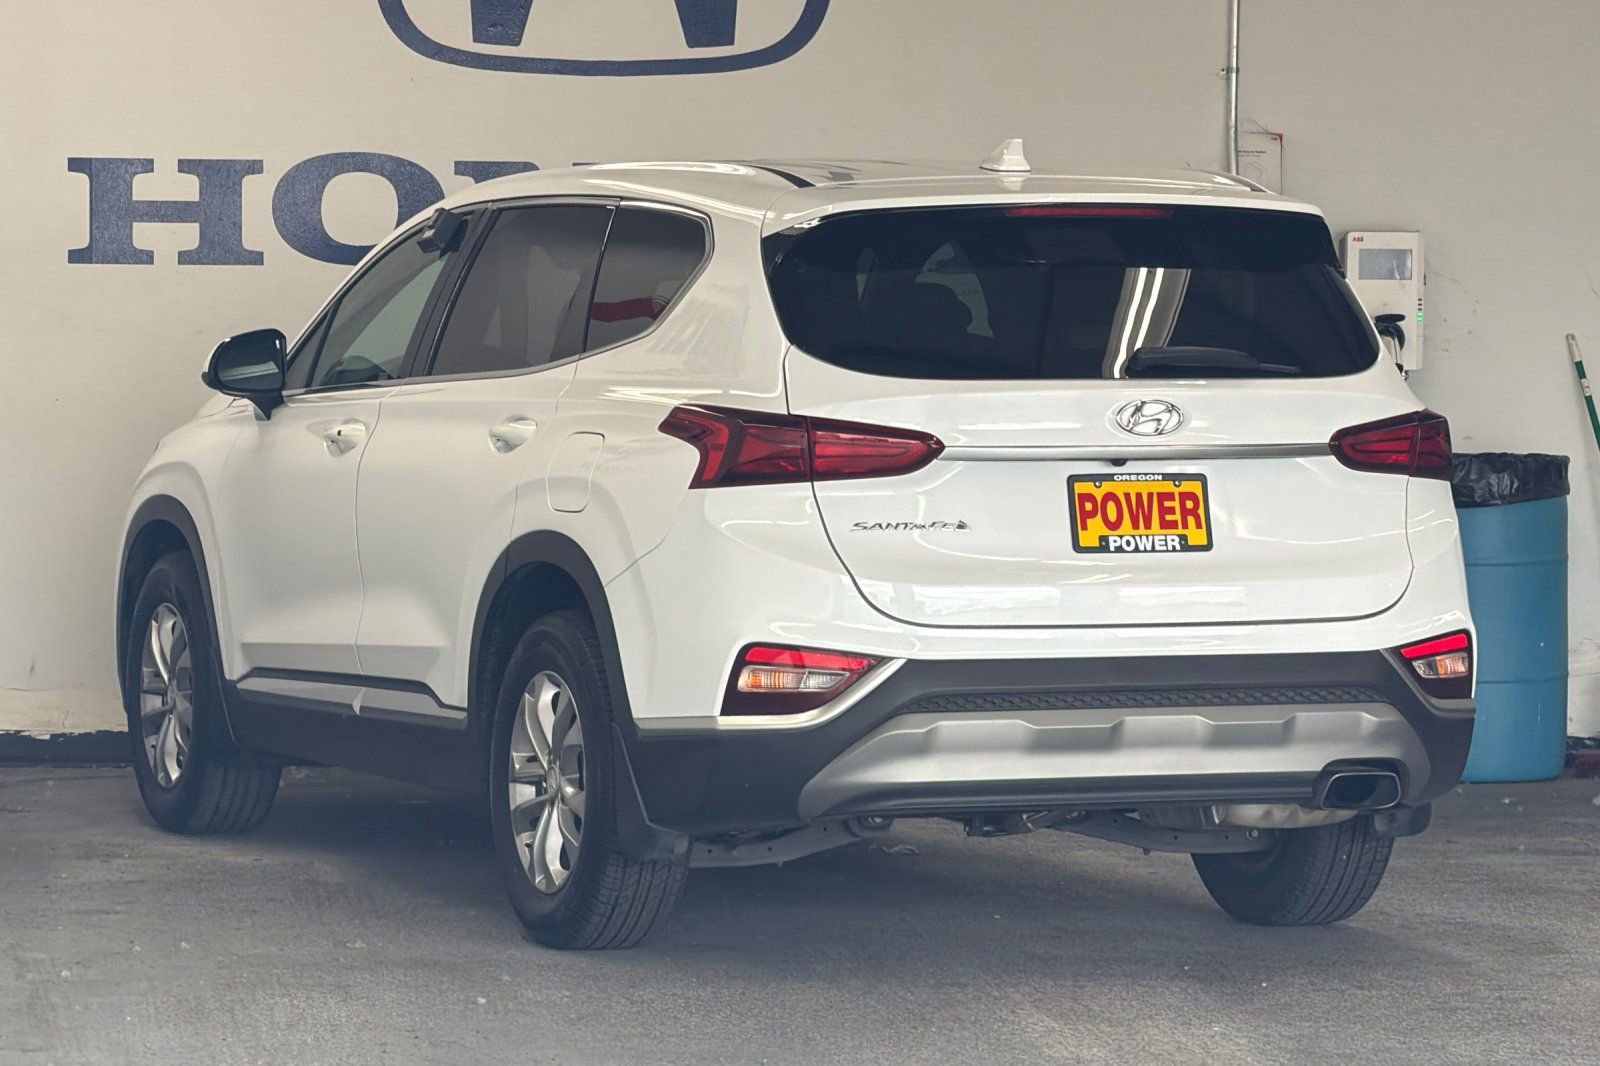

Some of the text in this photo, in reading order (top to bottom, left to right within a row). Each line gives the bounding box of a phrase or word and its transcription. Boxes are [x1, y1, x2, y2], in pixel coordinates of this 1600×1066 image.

[67, 152, 596, 265] HO
[1113, 474, 1163, 482] OREGON
[1077, 491, 1203, 531] POWER
[851, 521, 926, 531] SANTA
[1108, 535, 1181, 551] POWER
